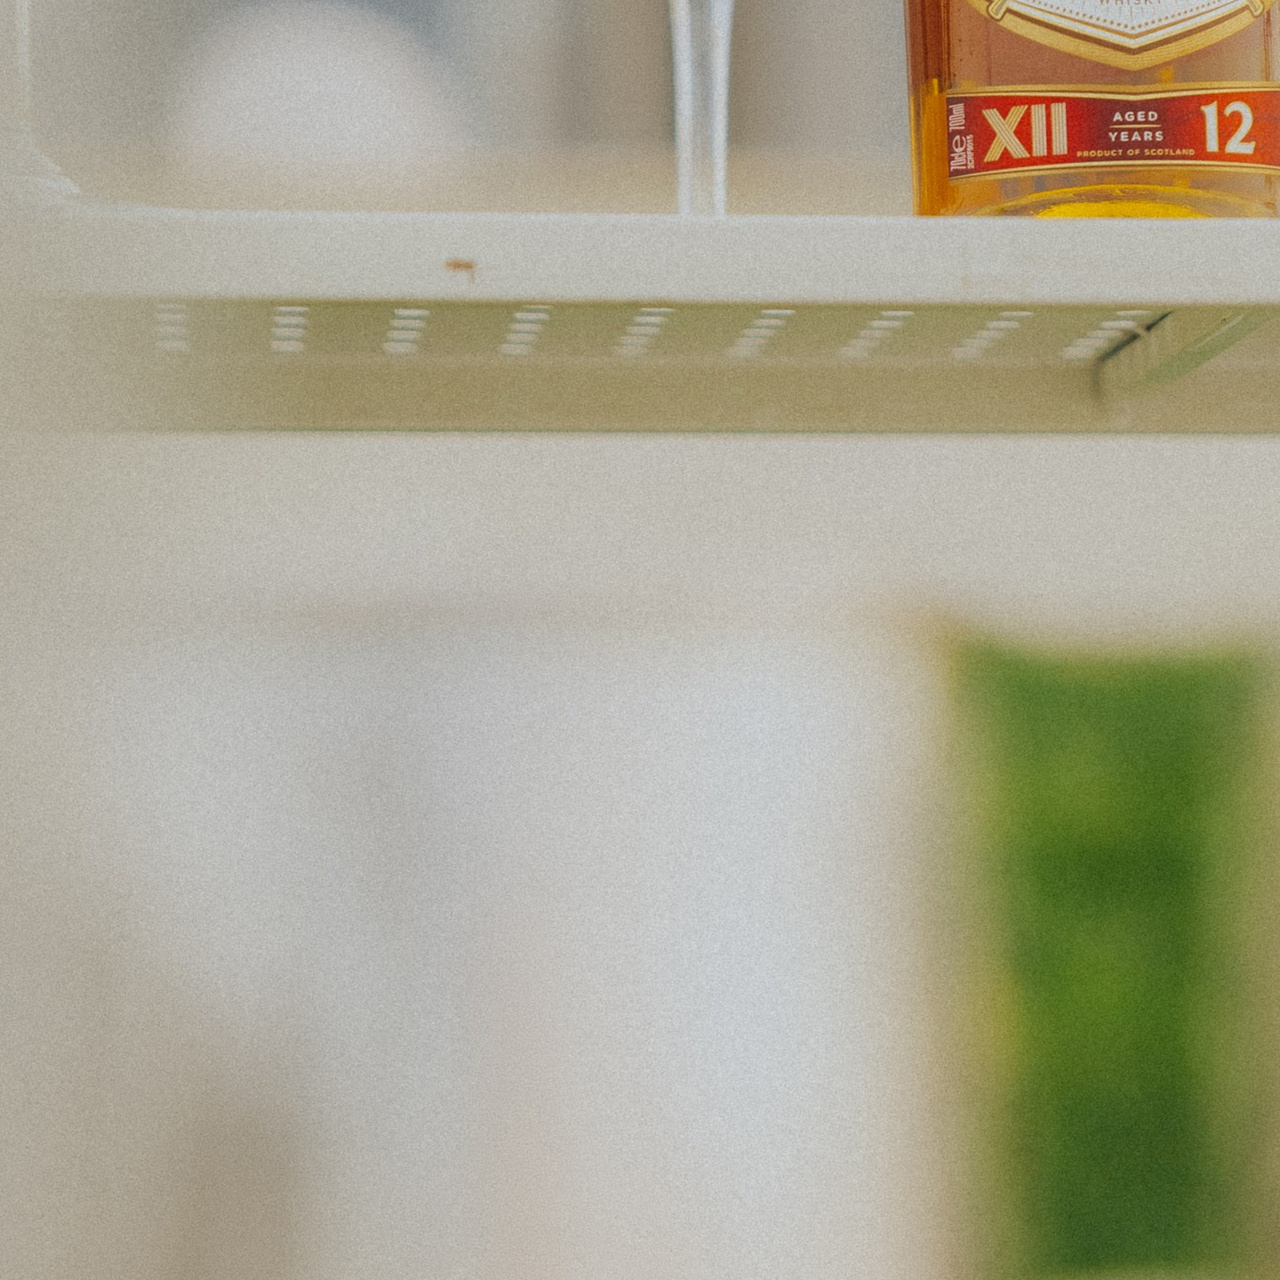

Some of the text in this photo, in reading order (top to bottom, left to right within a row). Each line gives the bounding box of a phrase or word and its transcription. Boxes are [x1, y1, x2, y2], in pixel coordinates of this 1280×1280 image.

[949, 103, 966, 133] 700ml
[1113, 111, 1158, 122] AGED
[981, 102, 1068, 163] XII
[1108, 131, 1164, 142] YEARS
[1201, 101, 1256, 154] 12
[1076, 148, 1196, 158] PRODUCT OF SCOTLAND
